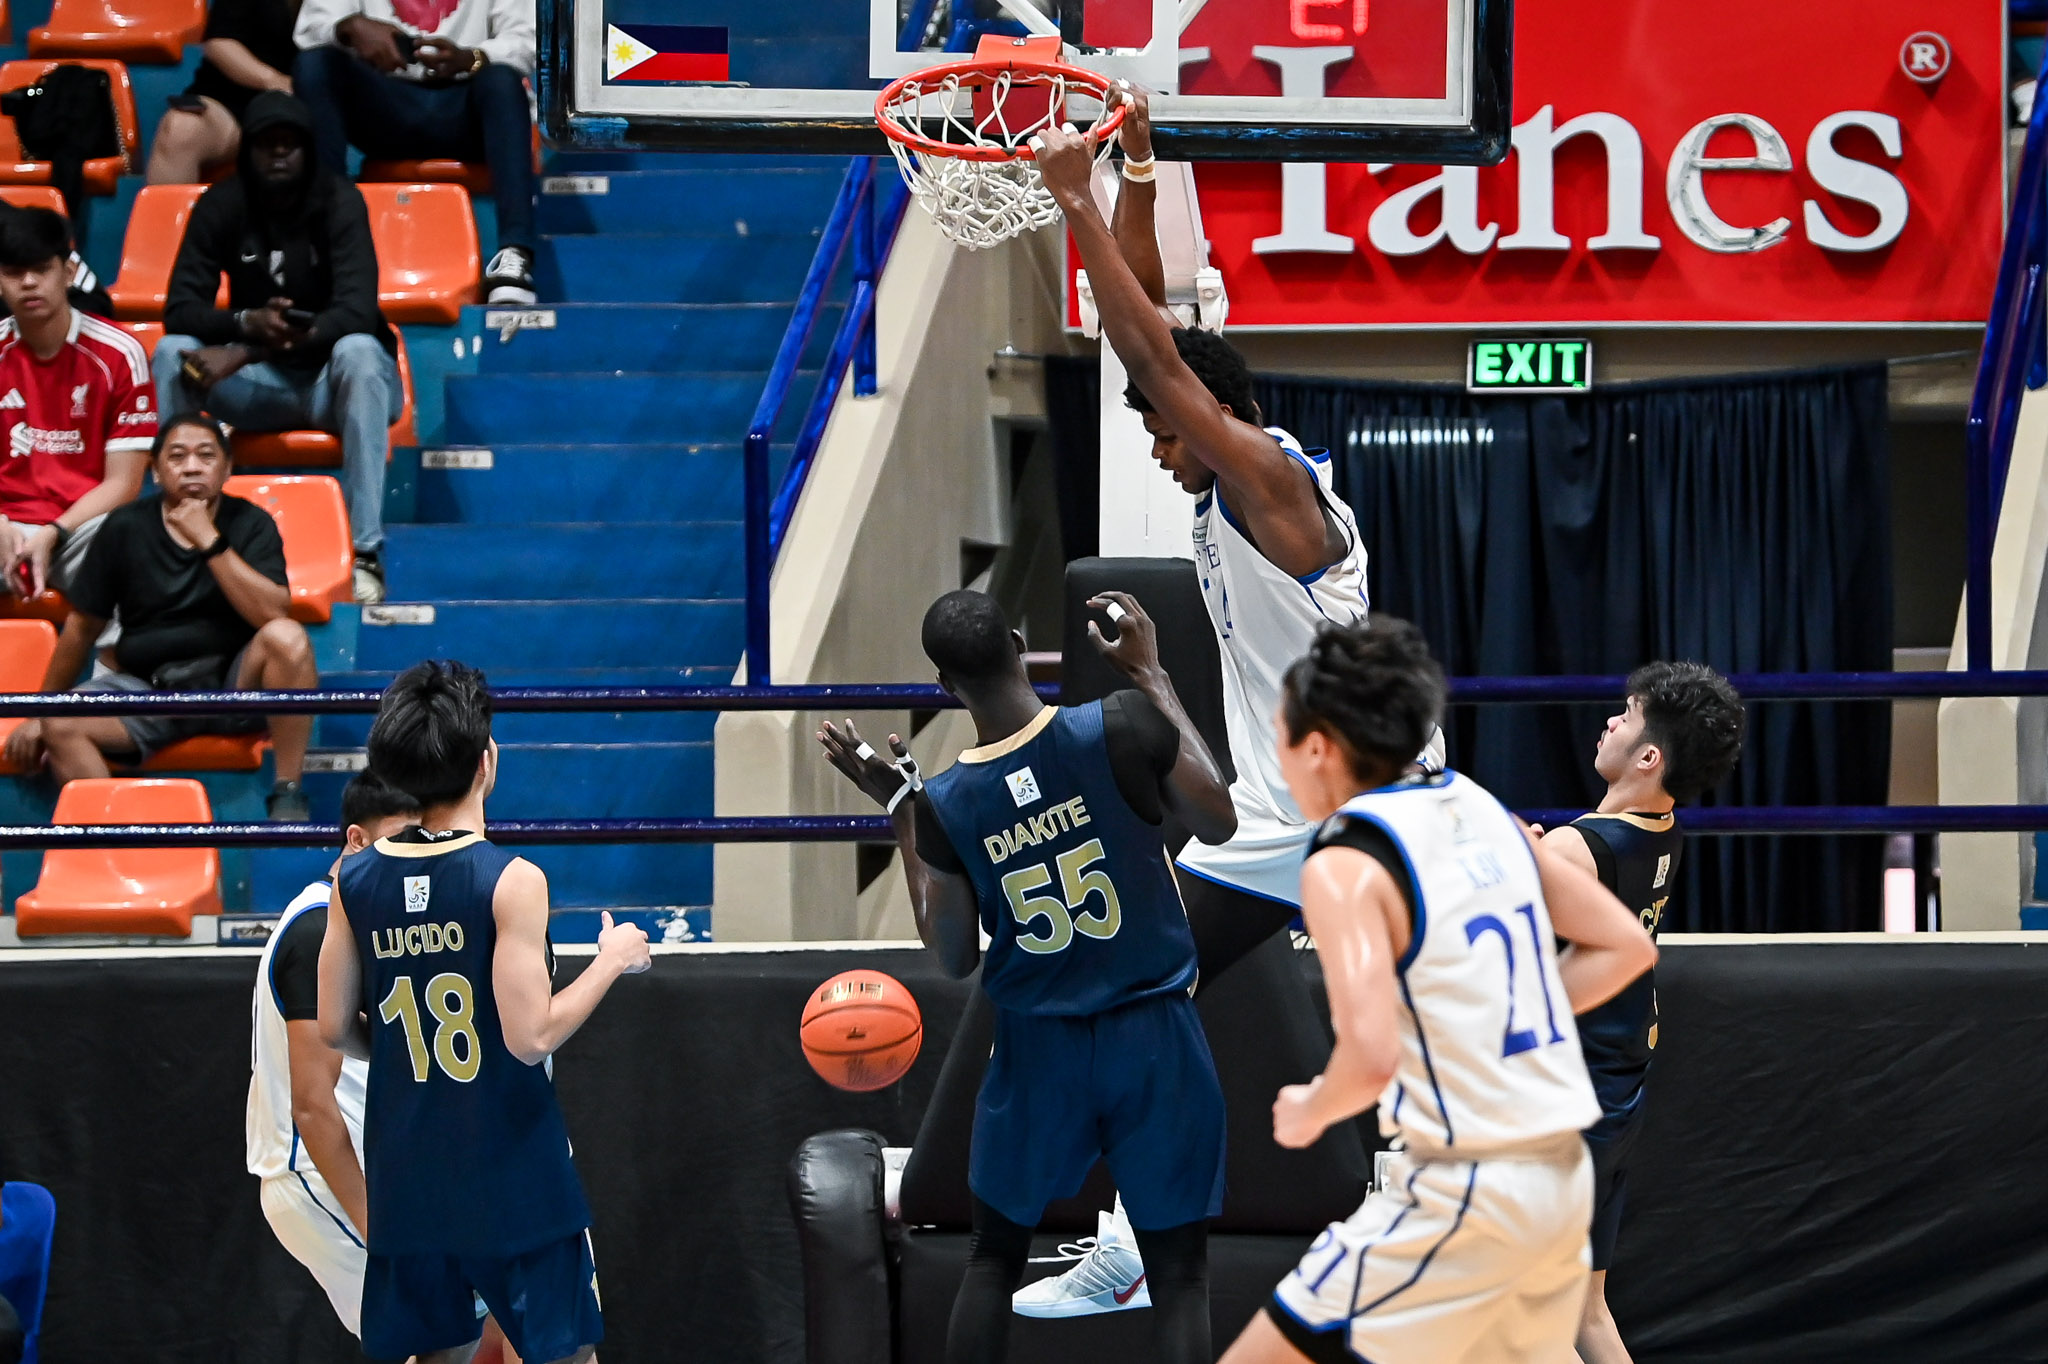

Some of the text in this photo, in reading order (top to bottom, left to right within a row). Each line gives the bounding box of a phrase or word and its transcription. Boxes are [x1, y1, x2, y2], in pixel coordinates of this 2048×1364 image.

[1475, 343, 1584, 383] EXIT
[984, 795, 1091, 864] DIAKITE
[372, 921, 465, 959] LUCIDO
[1001, 838, 1122, 954] 55
[1464, 902, 1565, 1058] 21
[378, 972, 481, 1083] 18
